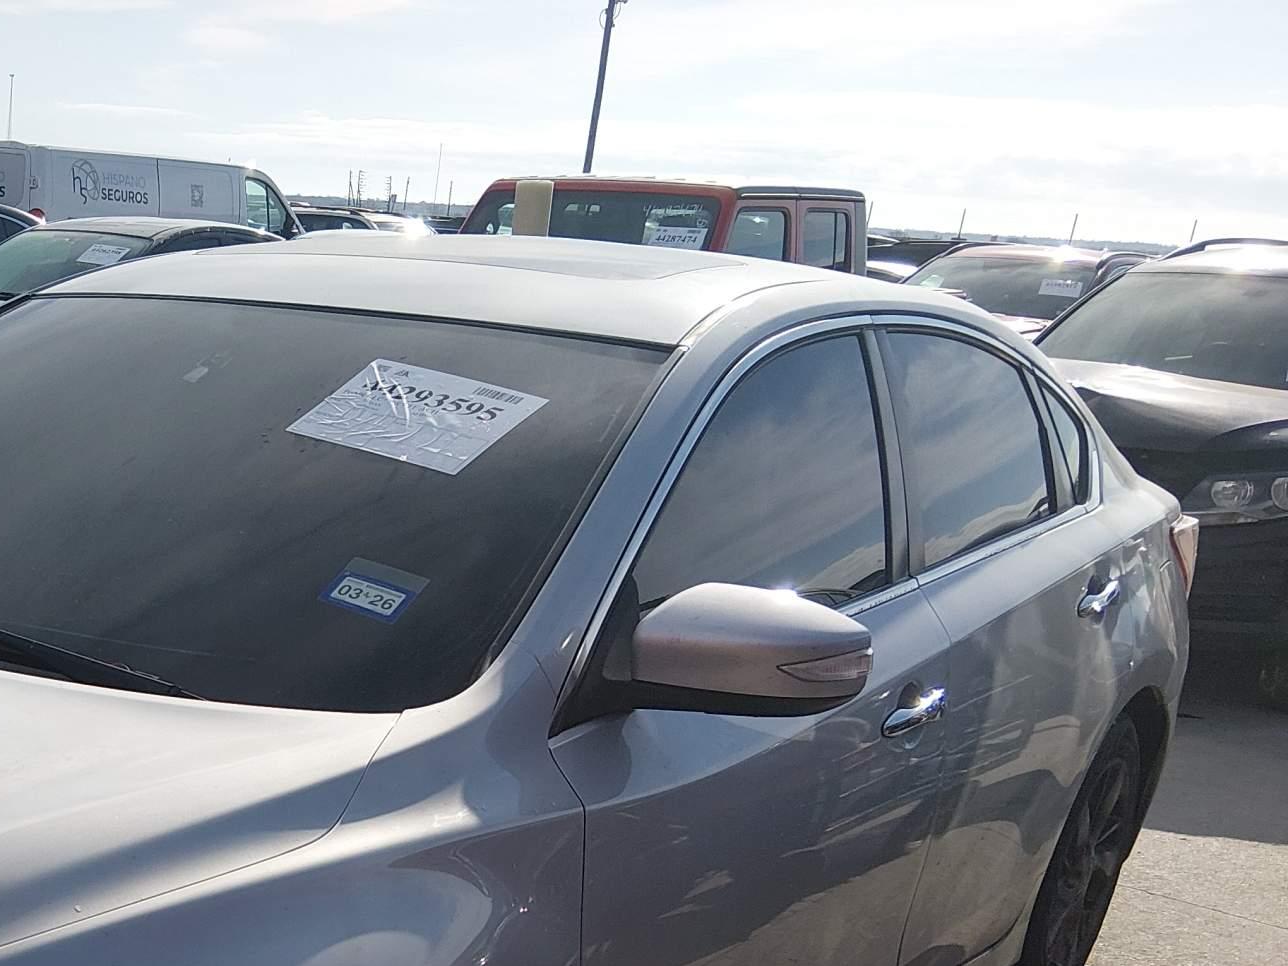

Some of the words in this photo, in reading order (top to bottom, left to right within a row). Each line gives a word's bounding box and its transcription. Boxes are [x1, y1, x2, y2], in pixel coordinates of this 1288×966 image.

[103, 171, 146, 189] HISPANO
[101, 187, 149, 205] SEGUROS
[655, 235, 698, 244] 44287474
[362, 379, 505, 421] 44293595
